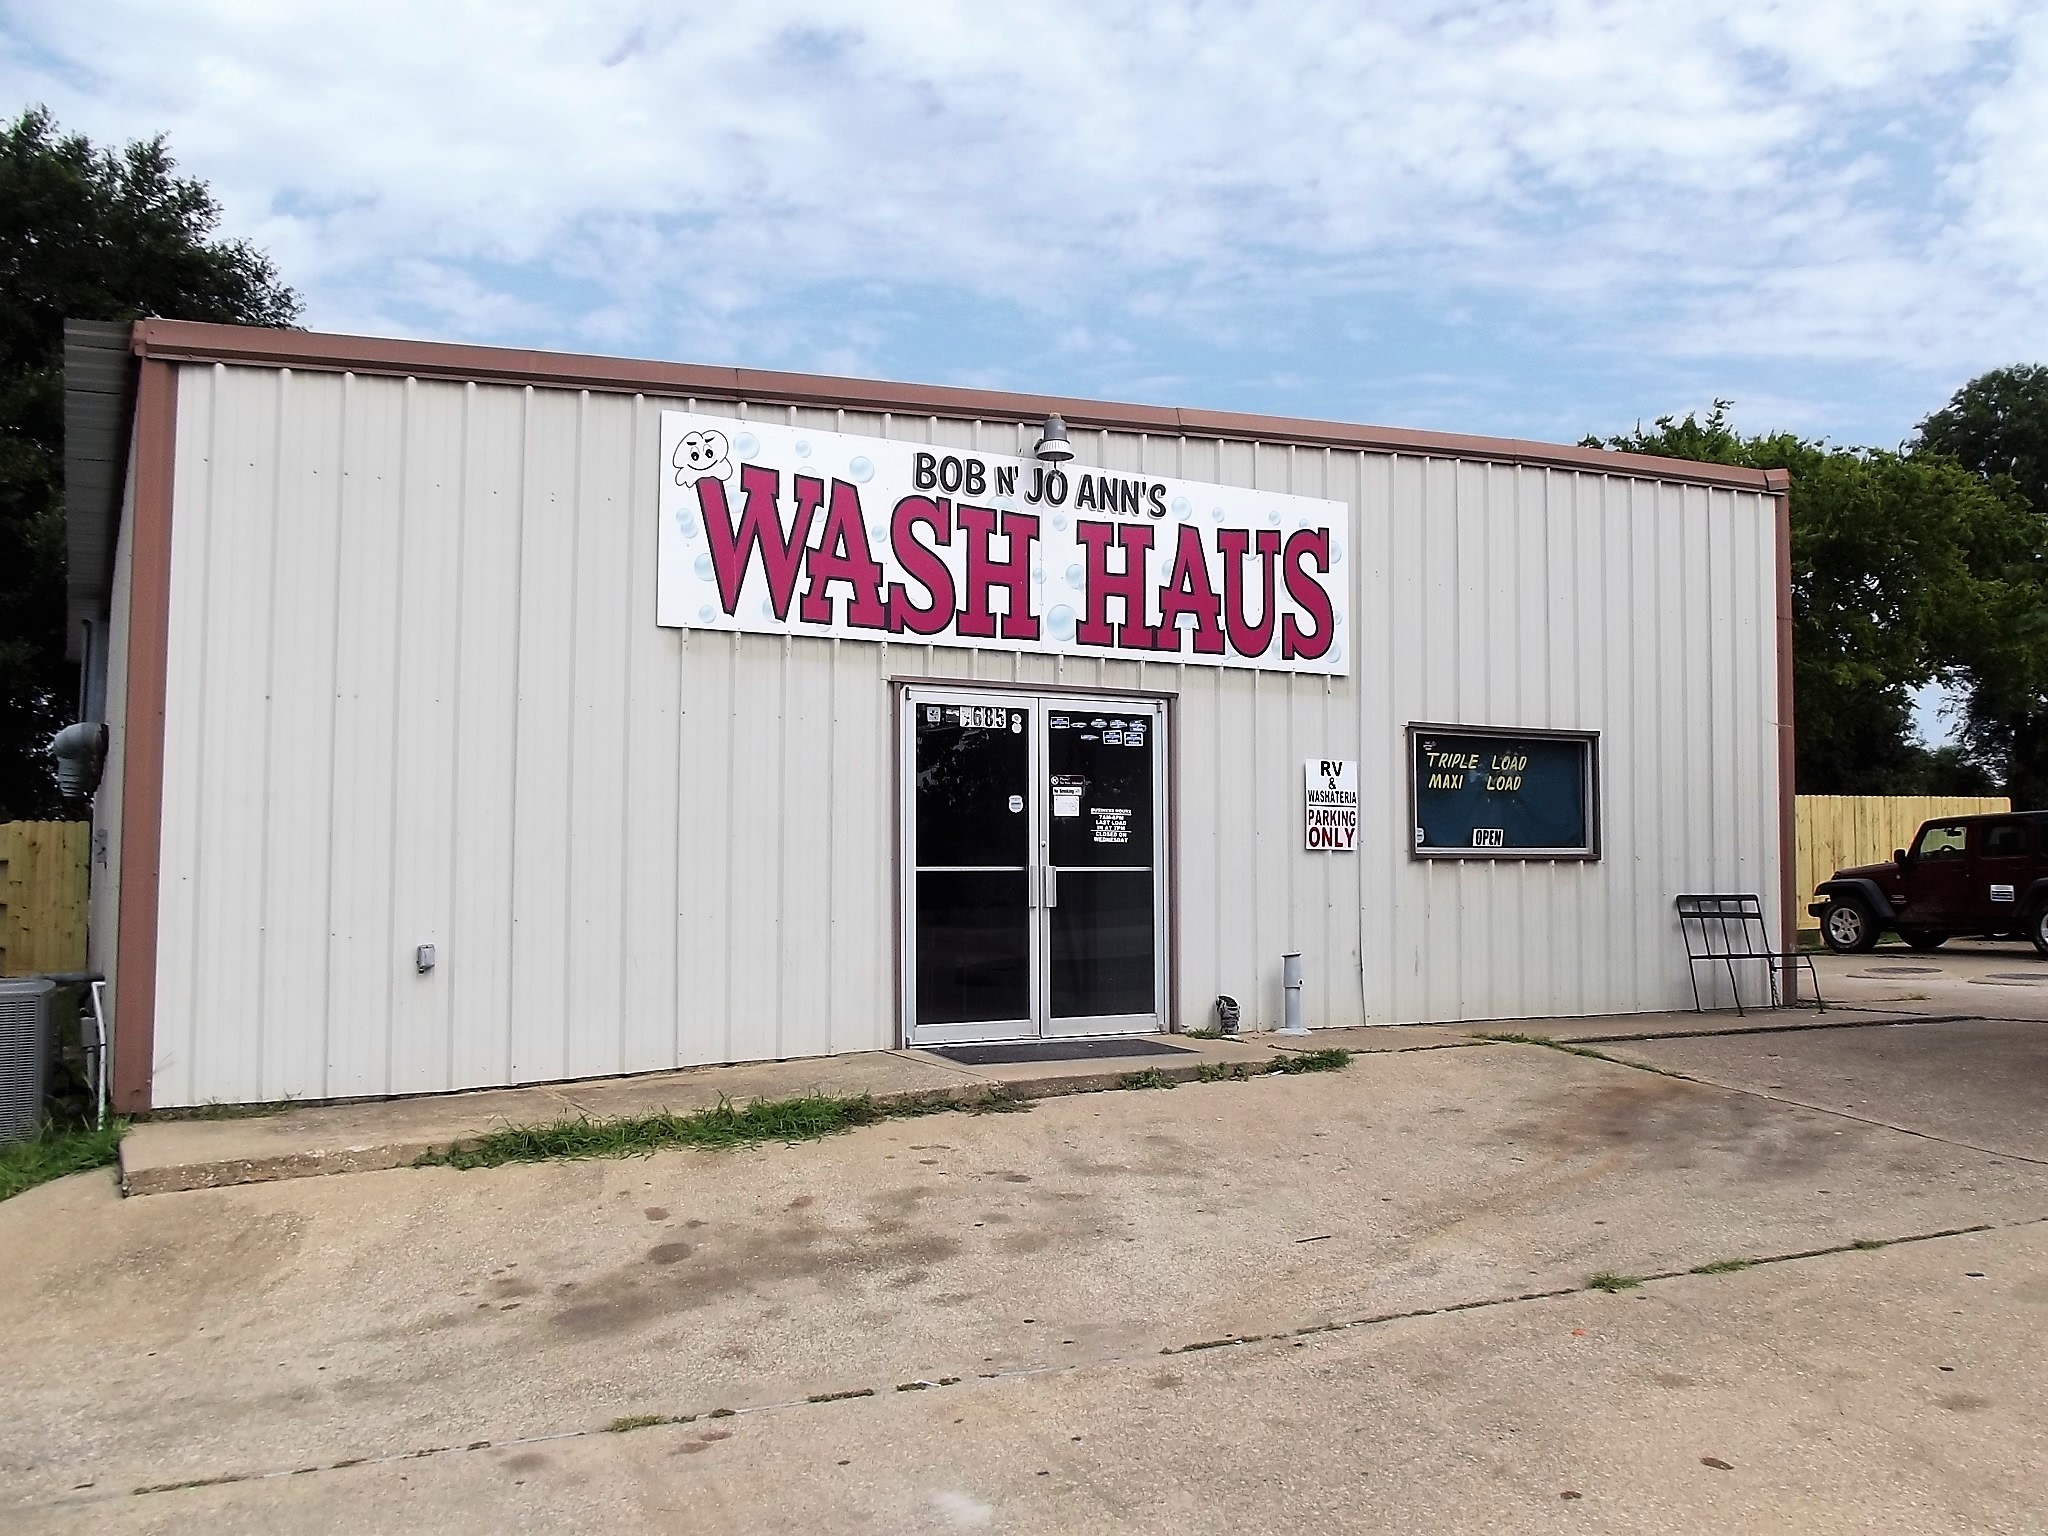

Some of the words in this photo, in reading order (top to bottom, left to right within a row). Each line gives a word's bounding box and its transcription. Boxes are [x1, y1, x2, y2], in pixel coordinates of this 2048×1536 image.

[914, 452, 987, 496] BOB
[996, 465, 1019, 495] N'
[1025, 467, 1069, 506] JO
[1075, 473, 1167, 518] ANN'S
[696, 463, 1040, 641] WASH
[1076, 519, 1335, 661] HAUS
[1320, 760, 1343, 776] RV
[1426, 752, 1480, 769] TRIPLE
[1491, 754, 1527, 771] LOAD
[1328, 777, 1337, 790] &
[1428, 773, 1464, 789] MAXI
[1486, 775, 1522, 791] LOAD
[1307, 789, 1357, 804] WASHATERIA
[1308, 809, 1356, 827] PARKING
[1308, 826, 1356, 848] ONLY
[1475, 829, 1502, 846] OPEN
